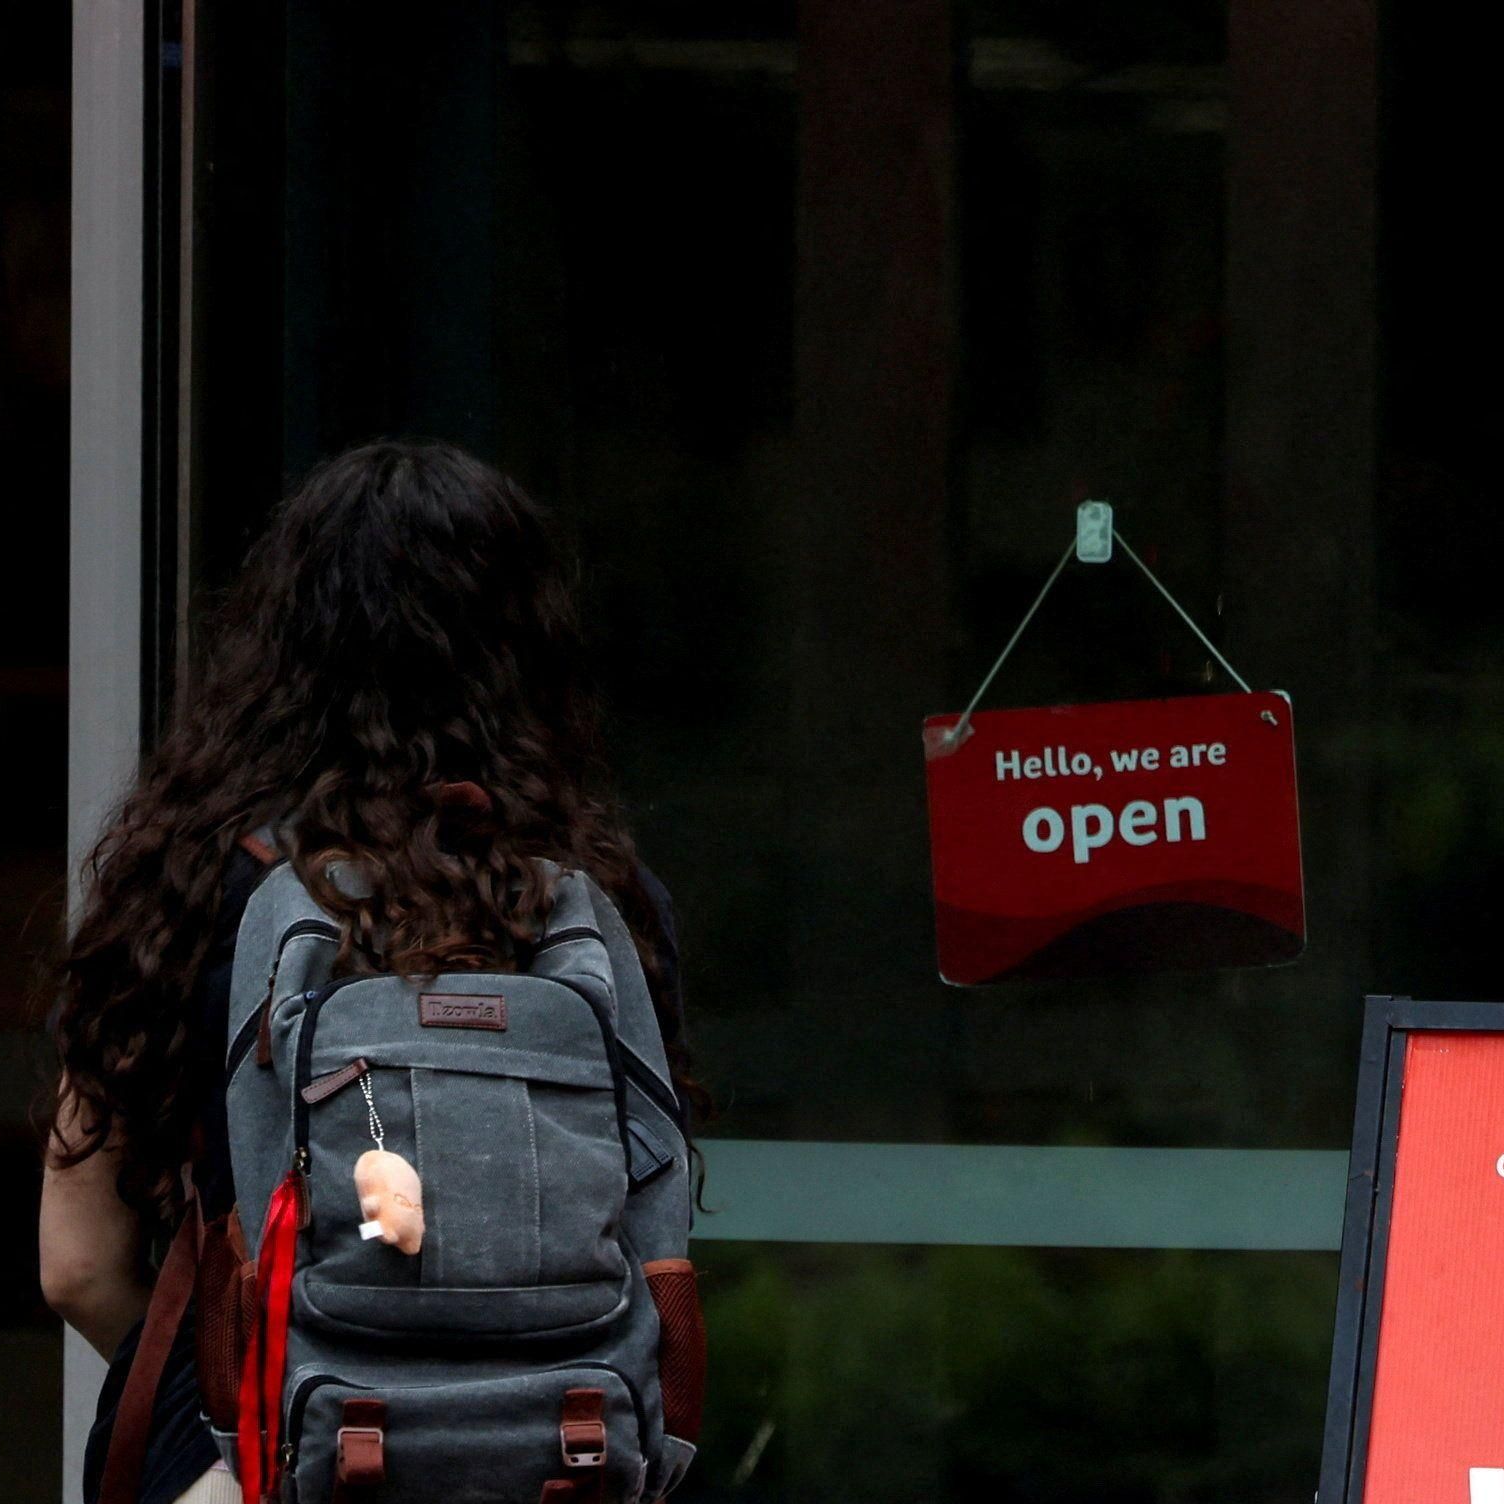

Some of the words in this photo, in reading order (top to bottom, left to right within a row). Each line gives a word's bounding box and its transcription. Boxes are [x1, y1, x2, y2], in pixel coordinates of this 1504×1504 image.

[995, 745, 1103, 781] Hello,
[1110, 748, 1160, 772] we
[1169, 742, 1227, 768] are
[1022, 796, 1206, 864] open
